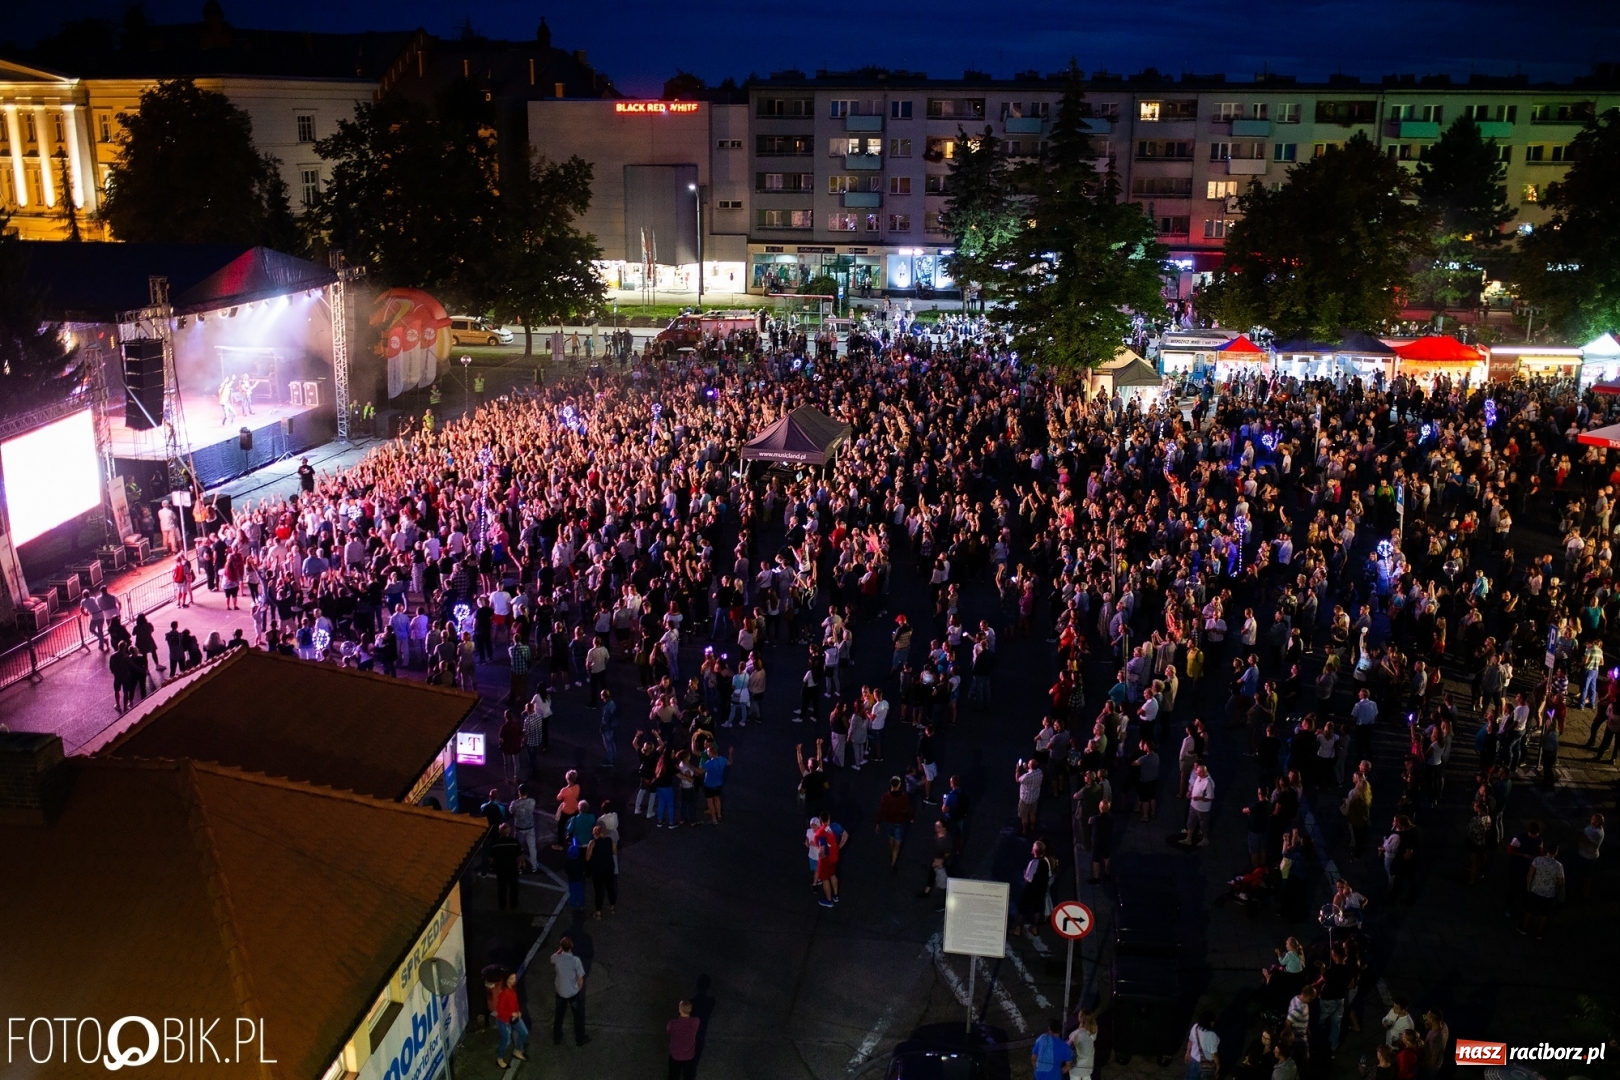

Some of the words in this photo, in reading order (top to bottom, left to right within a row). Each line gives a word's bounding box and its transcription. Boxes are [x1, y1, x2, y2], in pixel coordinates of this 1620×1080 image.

[615, 103, 645, 112] BLACK
[647, 103, 666, 112] RED
[759, 451, 806, 460] www.musicland.pl
[1549, 628, 1556, 649] P
